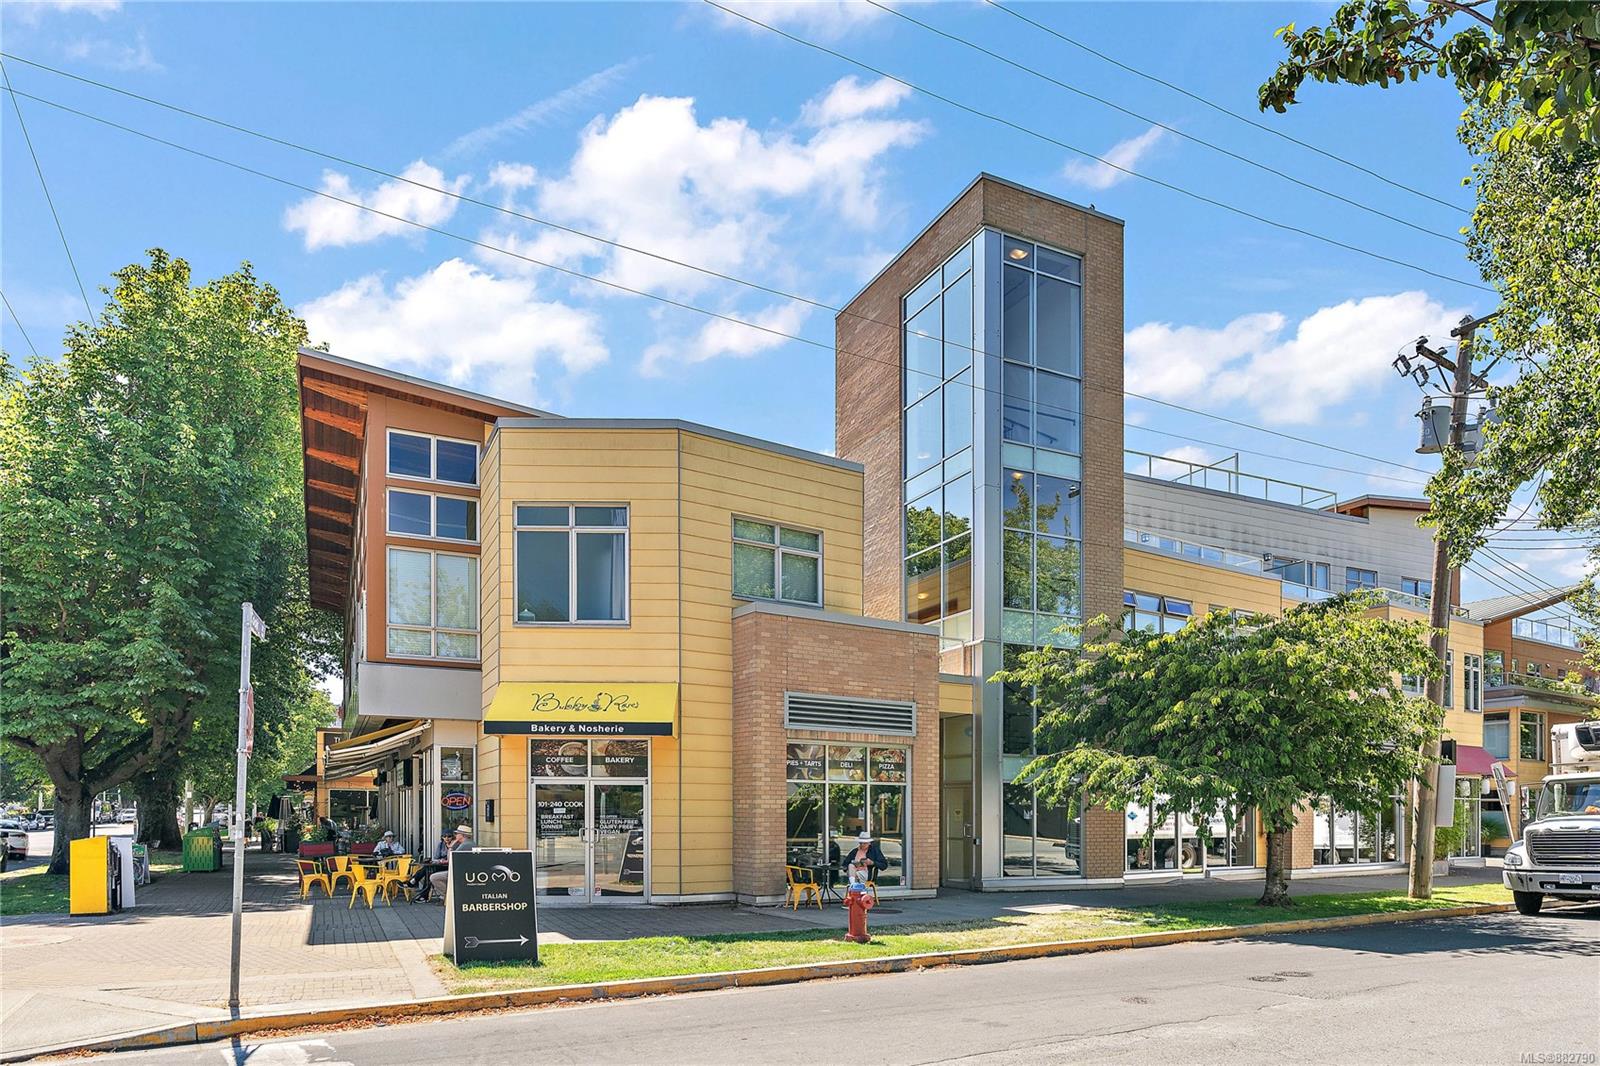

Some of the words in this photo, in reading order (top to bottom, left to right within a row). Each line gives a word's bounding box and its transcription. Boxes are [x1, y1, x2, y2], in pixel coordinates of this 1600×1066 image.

[531, 724, 567, 734] Bakery
[568, 724, 576, 732] &
[578, 724, 625, 733] Nosherie
[441, 796, 472, 806] OPEN
[465, 871, 521, 883] UOMO
[462, 902, 528, 912] BARBERSHOP
